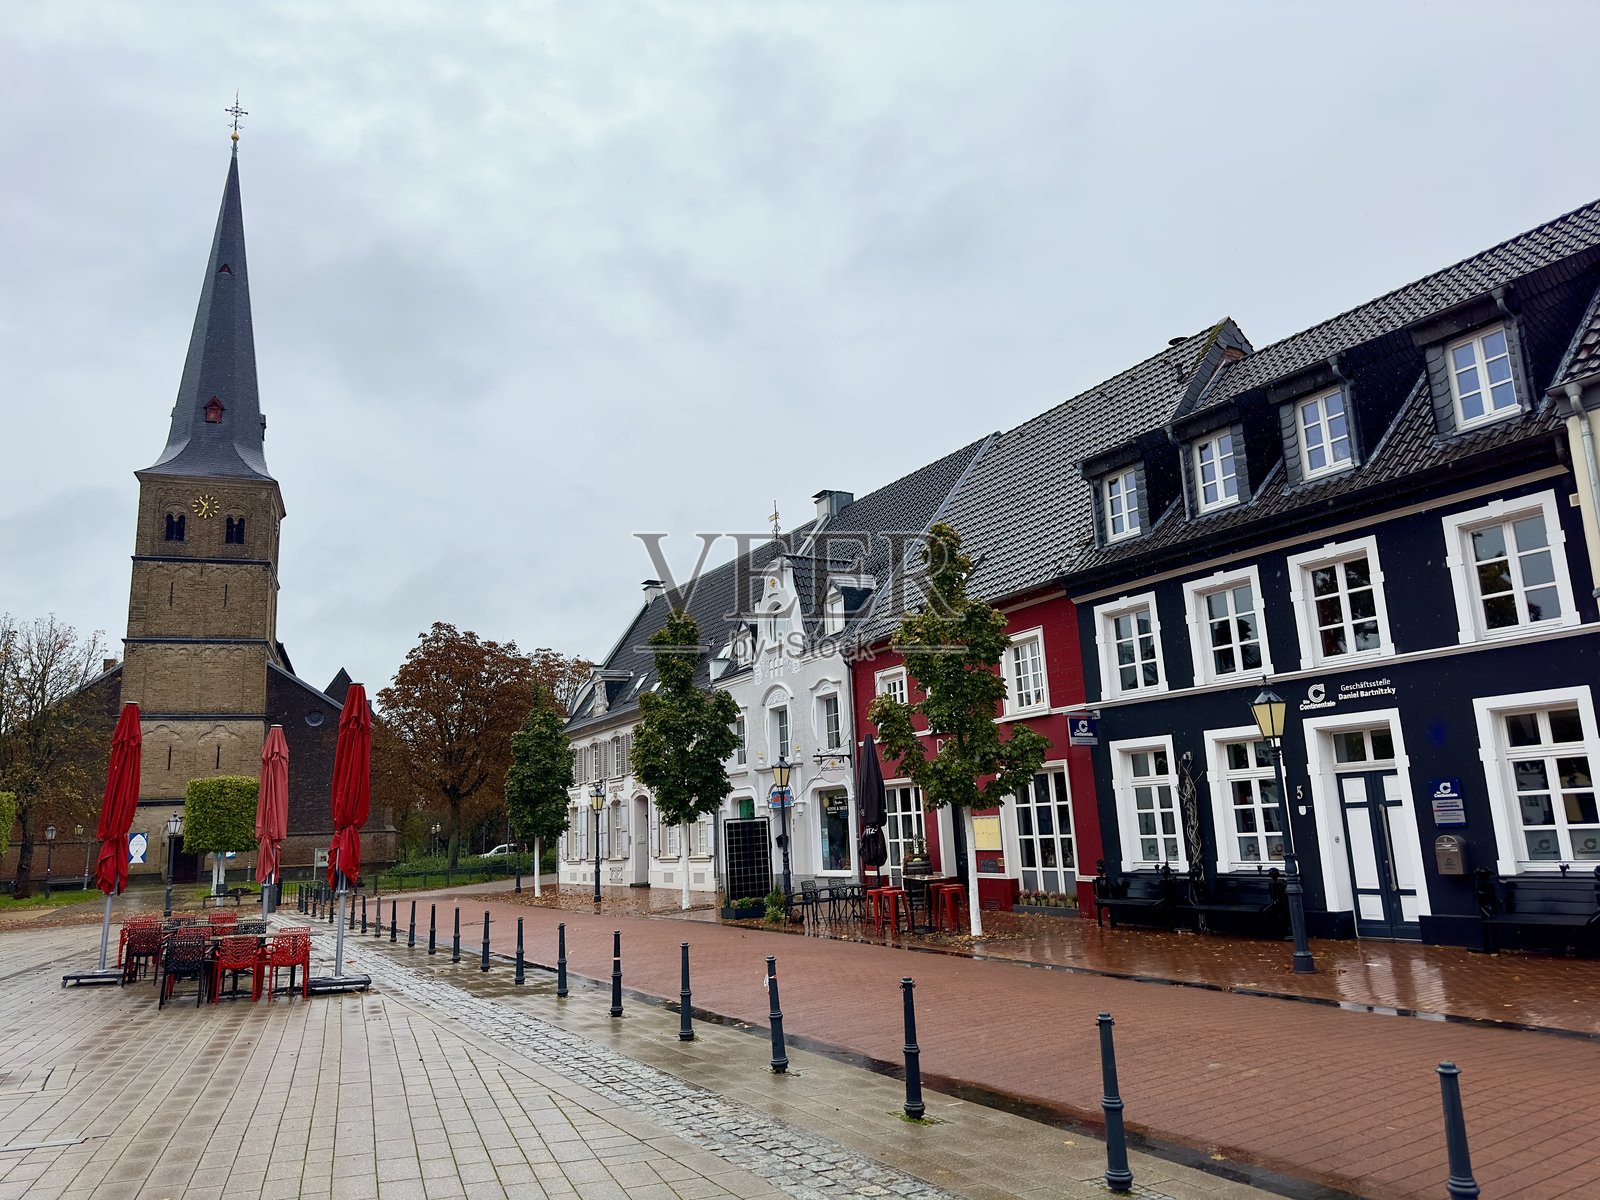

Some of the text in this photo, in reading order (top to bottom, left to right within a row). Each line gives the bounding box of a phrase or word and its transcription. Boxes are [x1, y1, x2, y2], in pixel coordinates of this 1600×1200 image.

[1340, 678, 1391, 691] Geschäftsstelle
[1338, 687, 1396, 700] Daniel Bartnitzky
[1300, 700, 1336, 710] Continentale
[1296, 785, 1303, 800] 5
